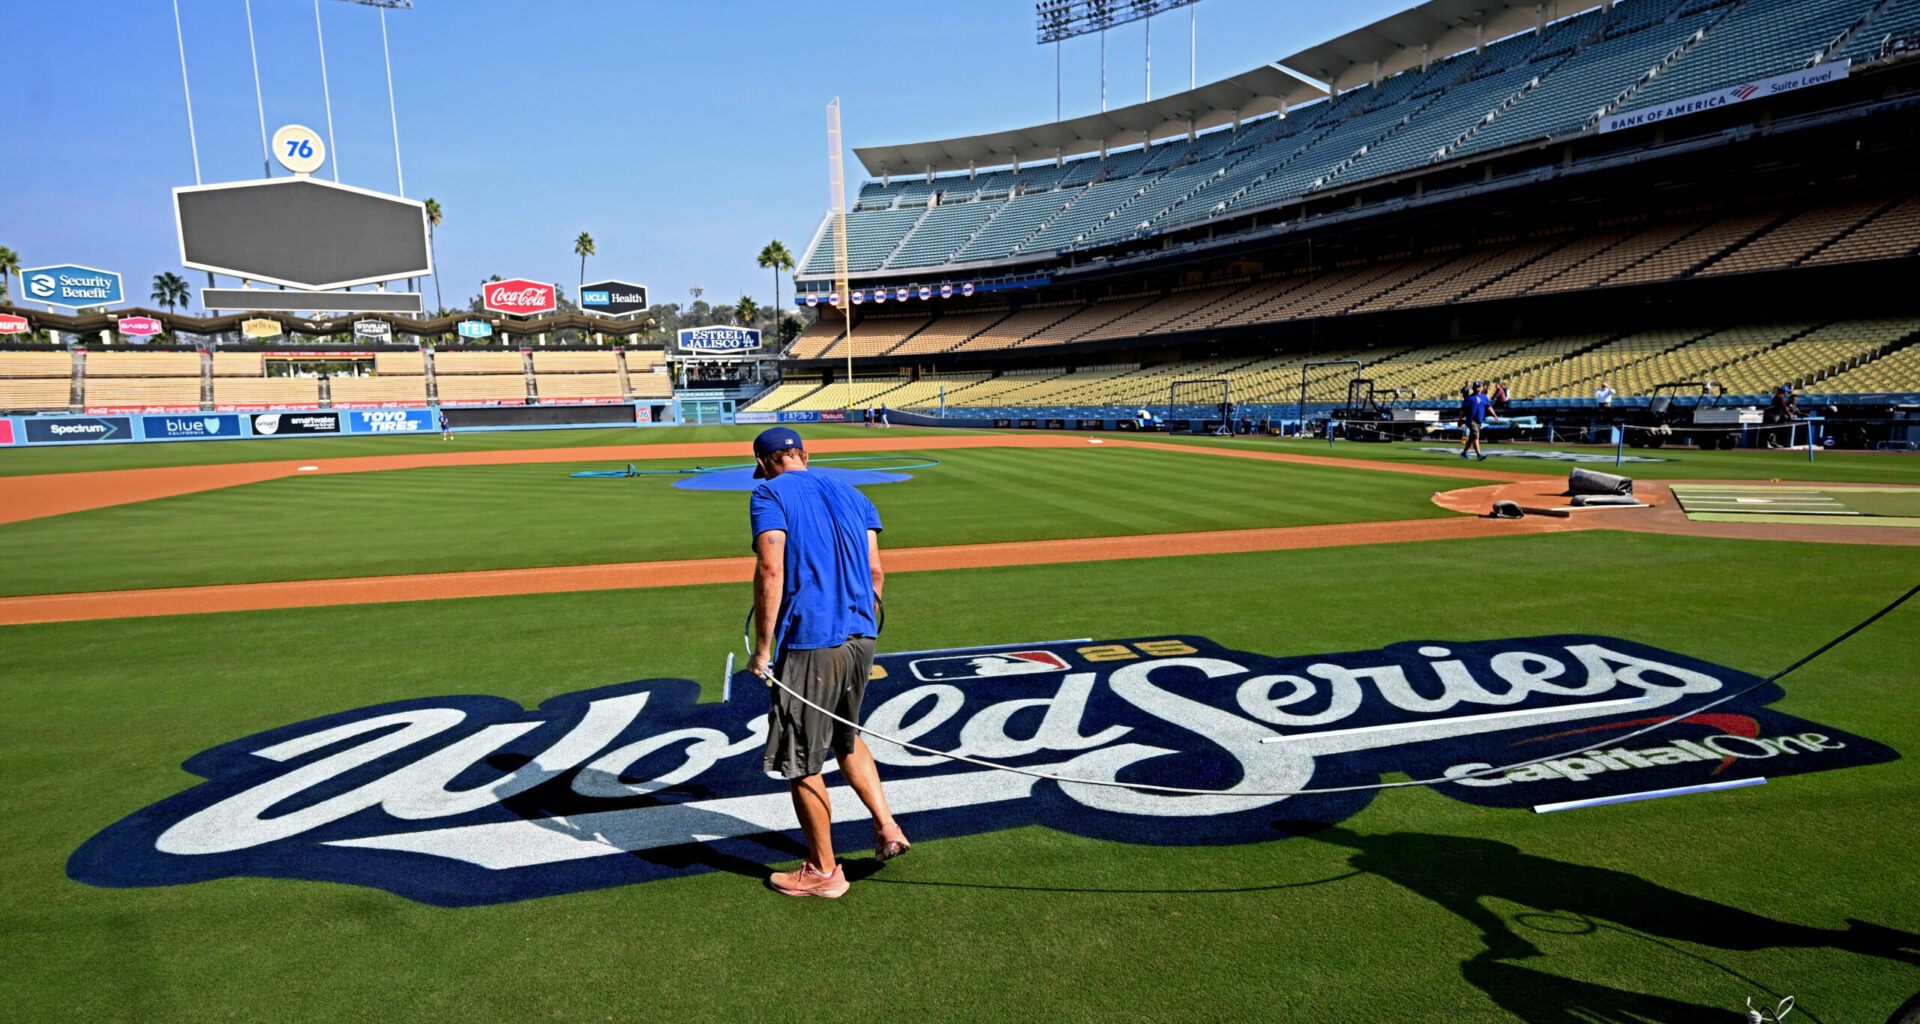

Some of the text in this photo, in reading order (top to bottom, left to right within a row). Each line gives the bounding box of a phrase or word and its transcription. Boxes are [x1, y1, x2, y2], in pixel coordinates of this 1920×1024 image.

[1771, 71, 1832, 94] Suite Level
[1611, 95, 1726, 130] BANK OF AMERICA
[286, 139, 313, 158] 76
[60, 275, 112, 289] Security
[62, 286, 107, 299] Benefit
[491, 287, 549, 307] Coca-Cola
[584, 293, 642, 303] UCLA Health
[462, 323, 489, 336] TEL
[687, 339, 740, 348] JALISCO
[362, 411, 407, 422] TOYO
[639, 410, 649, 418] 76
[821, 412, 845, 420] Yakult
[50, 424, 105, 435] Spectrum
[166, 418, 204, 431] blue
[370, 420, 418, 431] TIRES
[1056, 644, 1724, 817] Series
